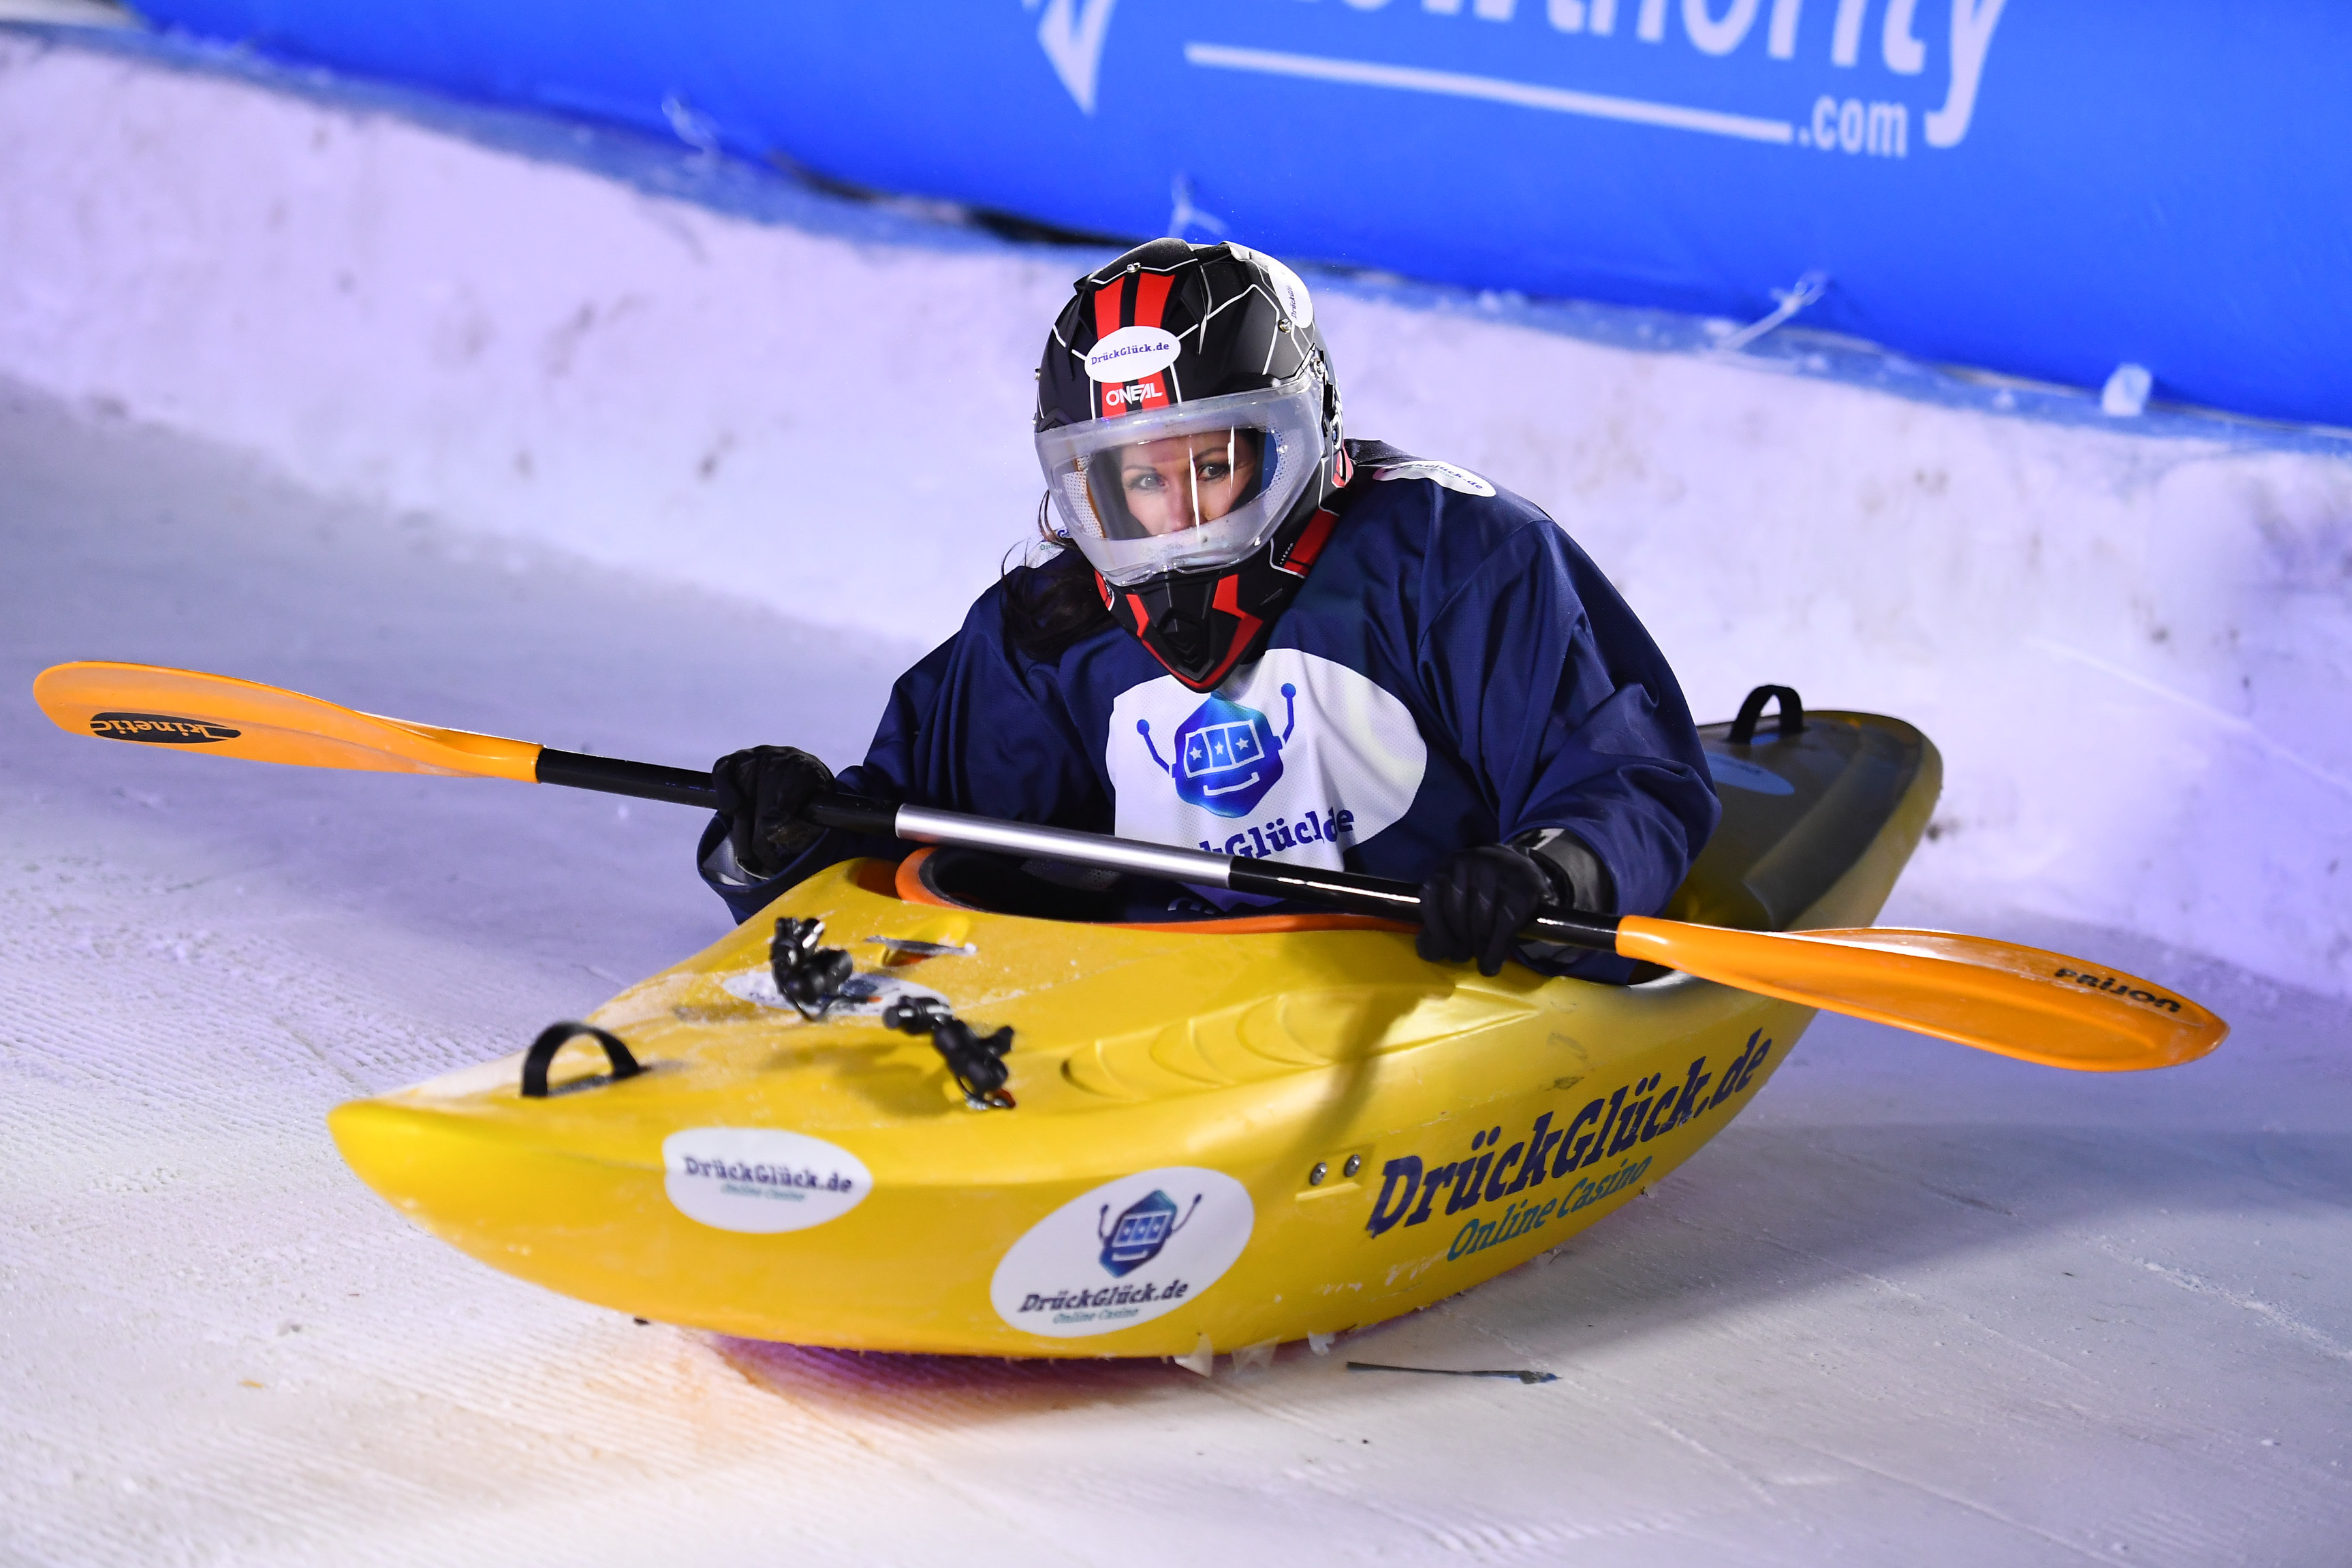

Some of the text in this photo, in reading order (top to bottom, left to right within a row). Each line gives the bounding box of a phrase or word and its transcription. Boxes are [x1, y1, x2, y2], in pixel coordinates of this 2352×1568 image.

[1799, 95, 1907, 159] .com
[1091, 342, 1170, 366] DrückGlück.de
[90, 720, 223, 739] kinetic
[1365, 1027, 1772, 1239] DrückGlück.de
[683, 1156, 853, 1193] DrückGlück.de
[1447, 1155, 1653, 1261] Online Casino
[1018, 1279, 1189, 1313] DrückGlück.de
